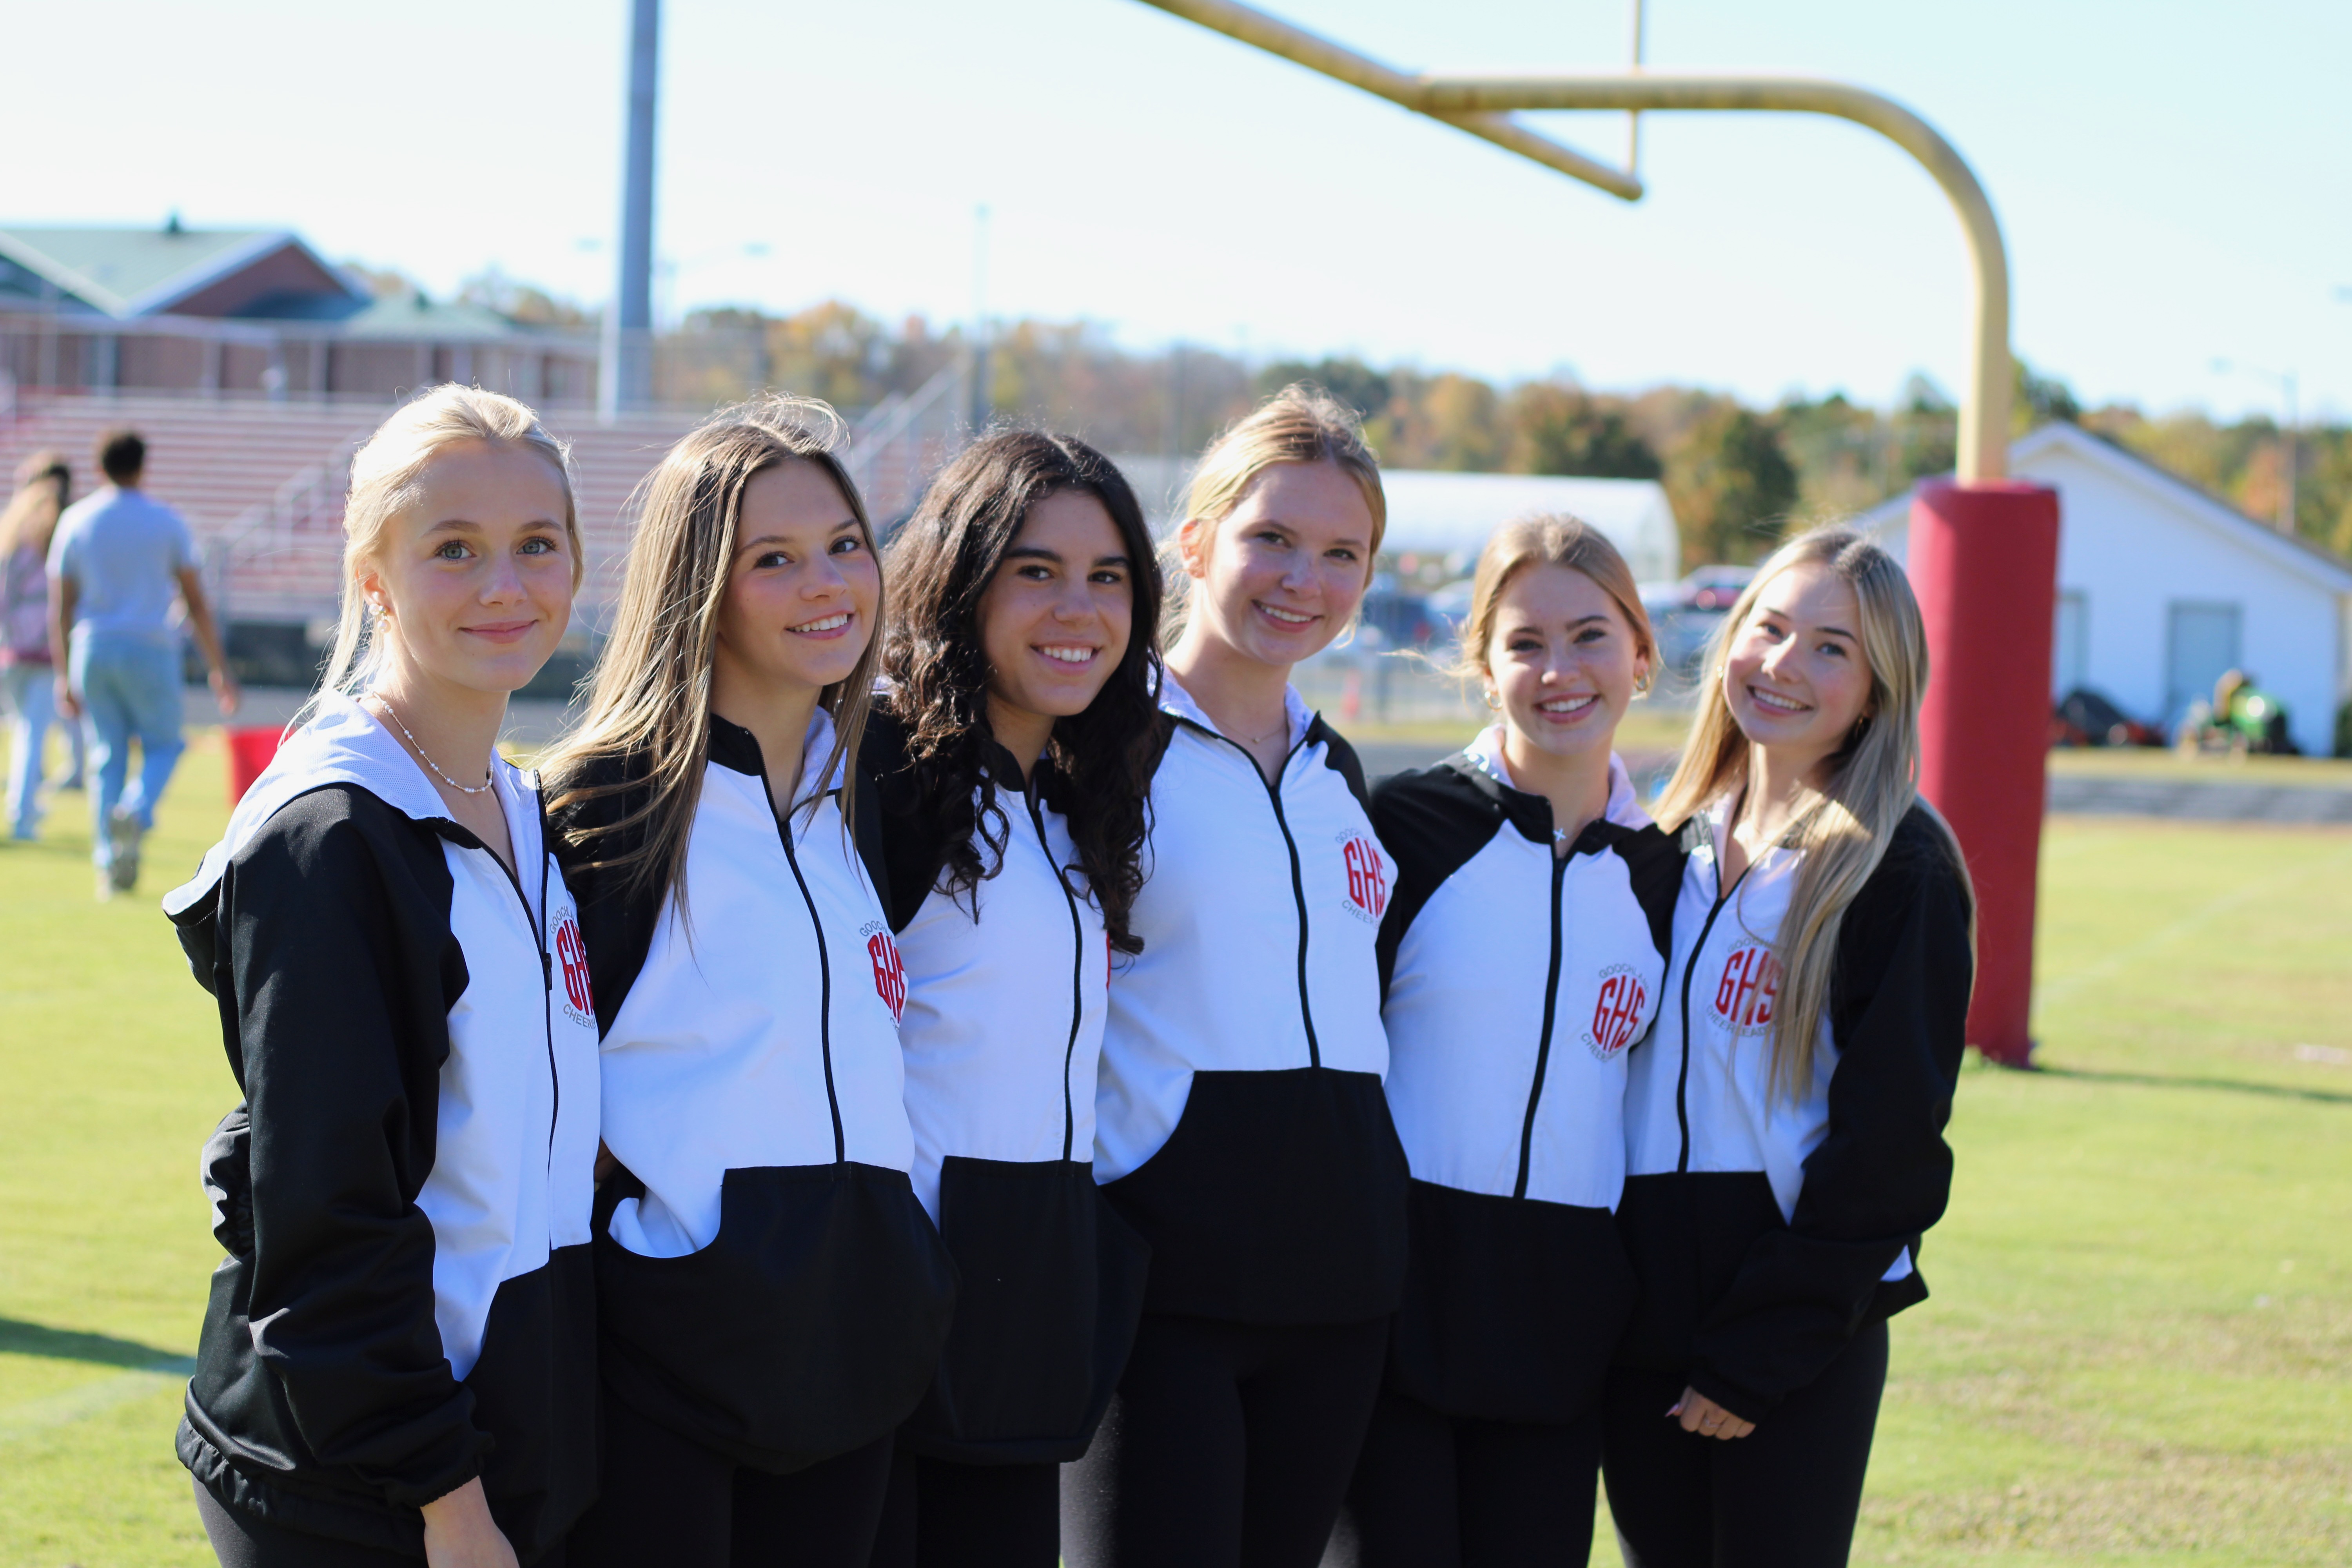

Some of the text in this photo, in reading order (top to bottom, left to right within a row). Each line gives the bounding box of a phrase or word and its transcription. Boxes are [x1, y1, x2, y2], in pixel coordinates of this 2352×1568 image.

[1343, 837, 1385, 918] GHS
[1593, 975, 1644, 1052] GHS
[1716, 948, 1784, 1025] GHS
